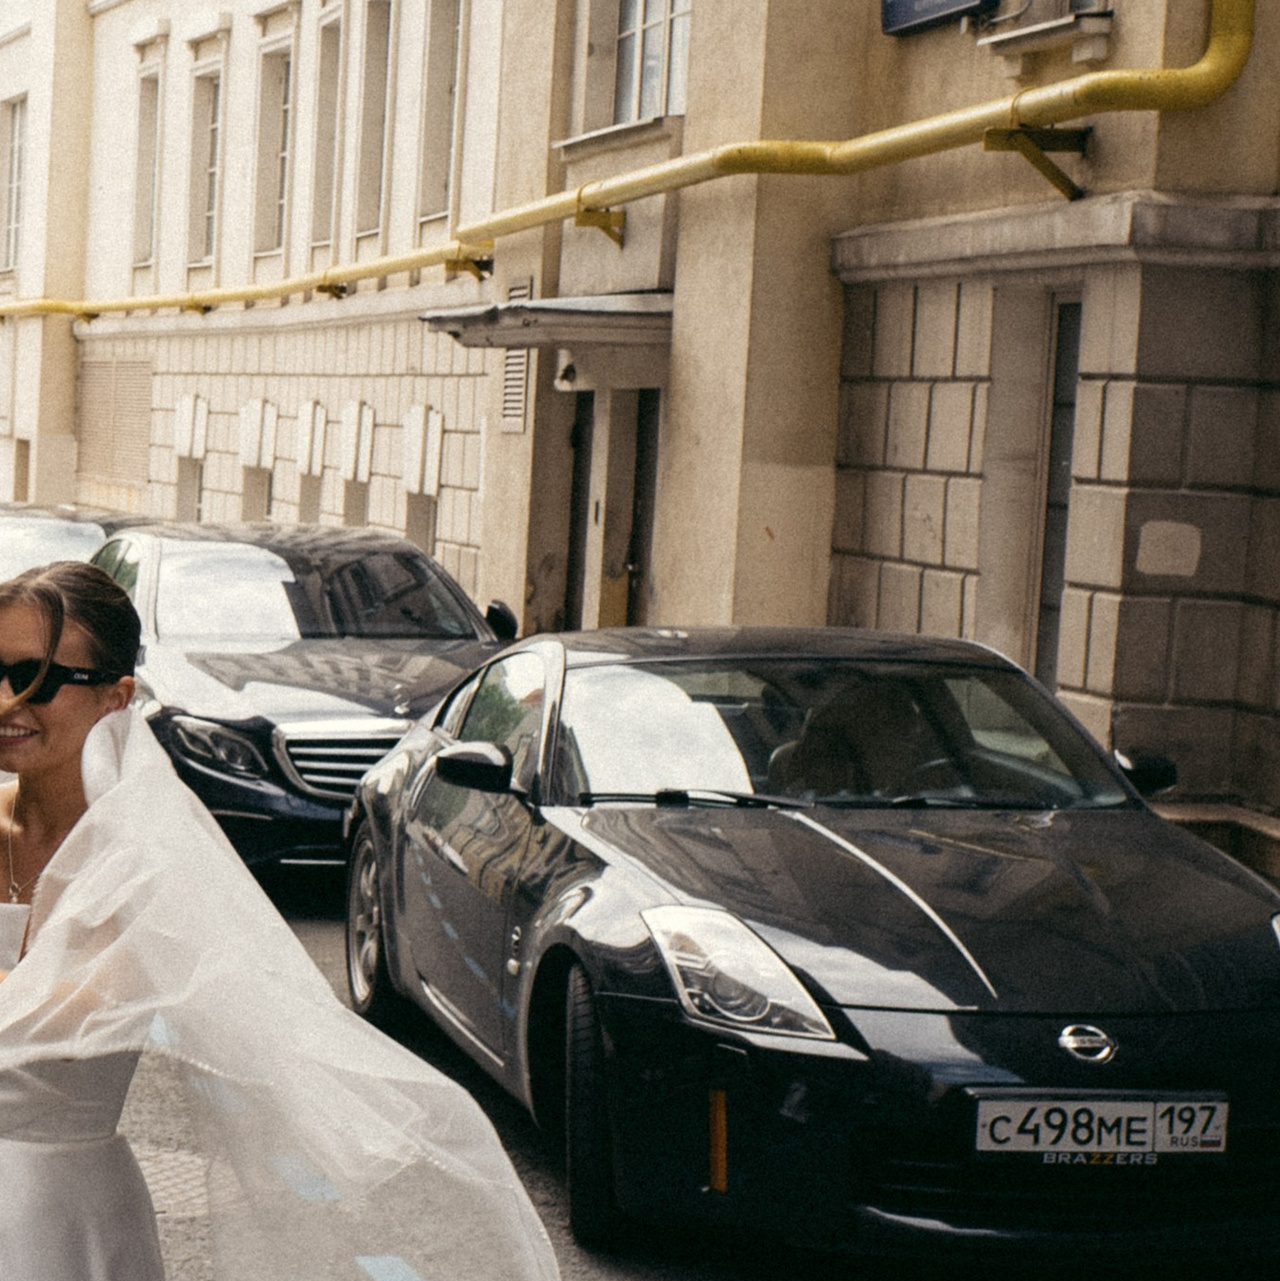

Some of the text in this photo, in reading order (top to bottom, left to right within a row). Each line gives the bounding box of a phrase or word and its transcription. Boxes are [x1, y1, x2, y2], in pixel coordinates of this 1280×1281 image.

[1159, 1105, 1217, 1136] 197
[1170, 1136, 1198, 1148] RUS
[1043, 1152, 1158, 1165] BRAZZERS
